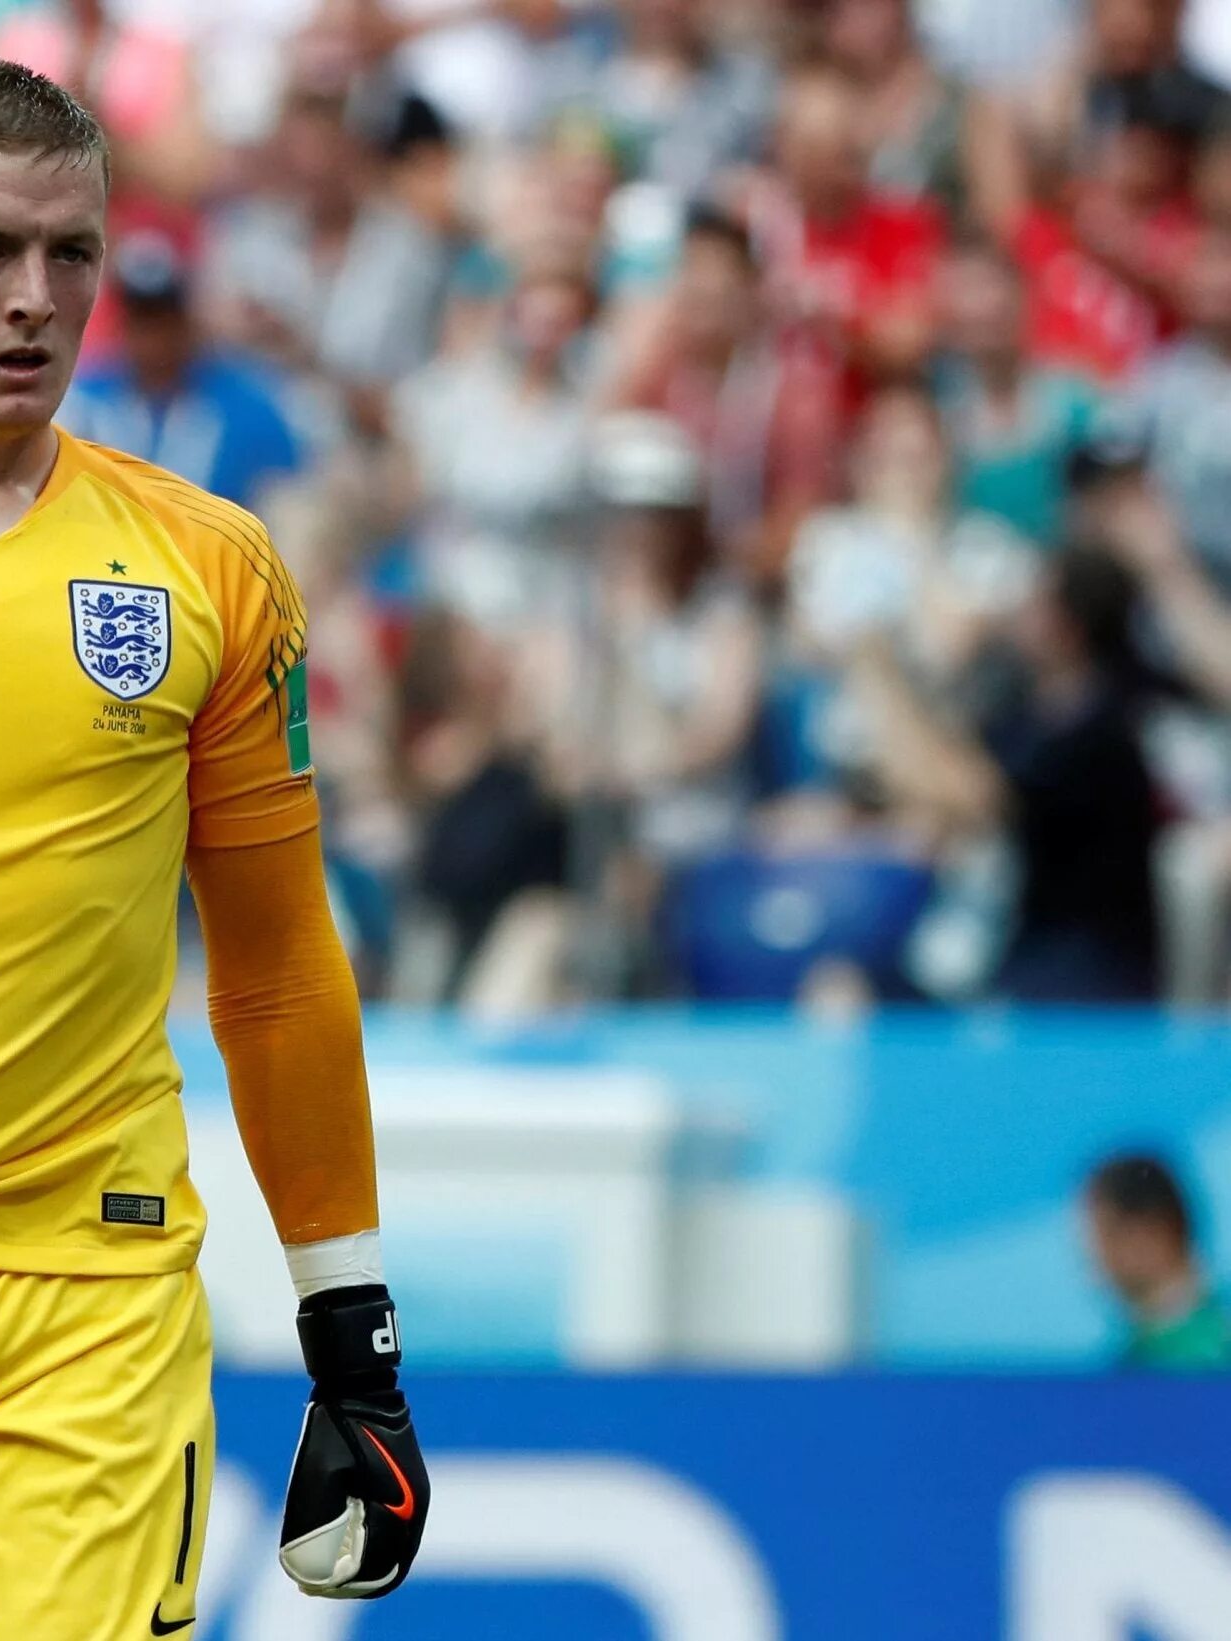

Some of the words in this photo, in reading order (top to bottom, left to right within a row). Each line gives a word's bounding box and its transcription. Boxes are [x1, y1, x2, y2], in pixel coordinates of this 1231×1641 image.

[102, 705, 141, 719] PANAMA
[92, 718, 105, 730] 24
[107, 719, 128, 733] JUNE
[174, 1441, 196, 1585] 1
